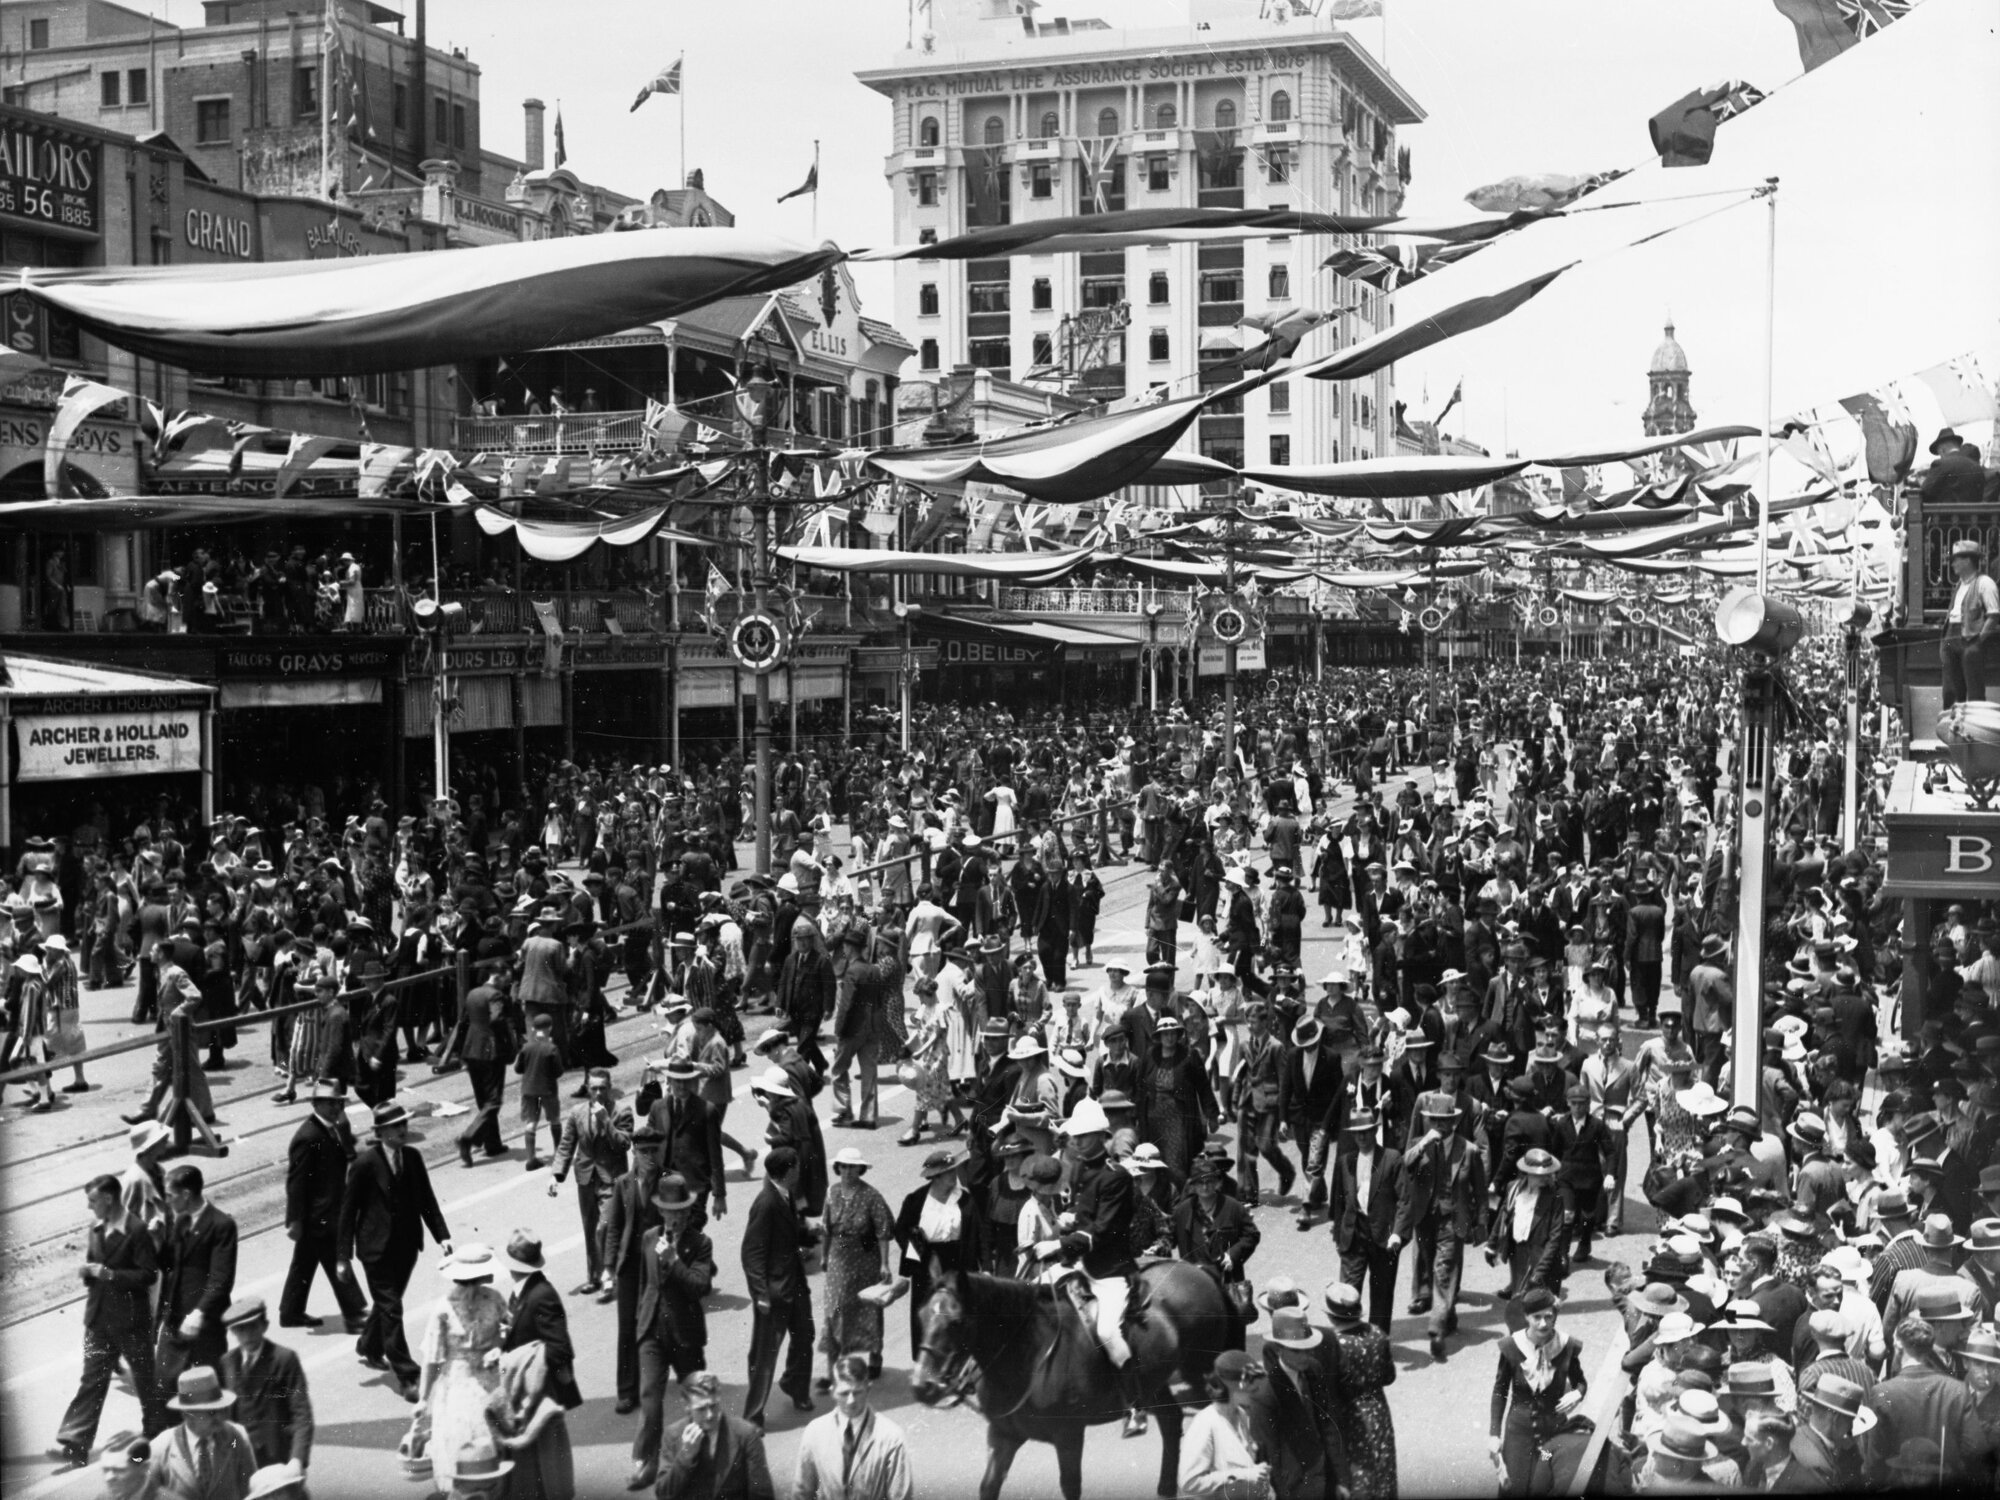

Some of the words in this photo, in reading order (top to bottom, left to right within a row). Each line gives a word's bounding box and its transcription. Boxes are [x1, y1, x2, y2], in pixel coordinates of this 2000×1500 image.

[946, 77, 1003, 95] MUTUAL
[1011, 74, 1044, 90] LIFE
[1053, 66, 1141, 88] ASSURANCE
[24, 185, 53, 219] 56
[61, 204, 92, 227] 1885
[186, 208, 250, 258] GRAND
[812, 330, 847, 356] ELLIS
[158, 480, 315, 493] AFTERNON
[227, 652, 272, 667] TAILORS
[279, 653, 344, 673] GRAYS
[42, 698, 101, 713] ARCHER
[117, 695, 178, 711] HOLLAND
[29, 727, 101, 747] ARCHER
[104, 727, 114, 743] &
[116, 723, 190, 742] HOLLAND
[64, 745, 160, 766] JEWELLERS.
[1944, 835, 1993, 874] B
